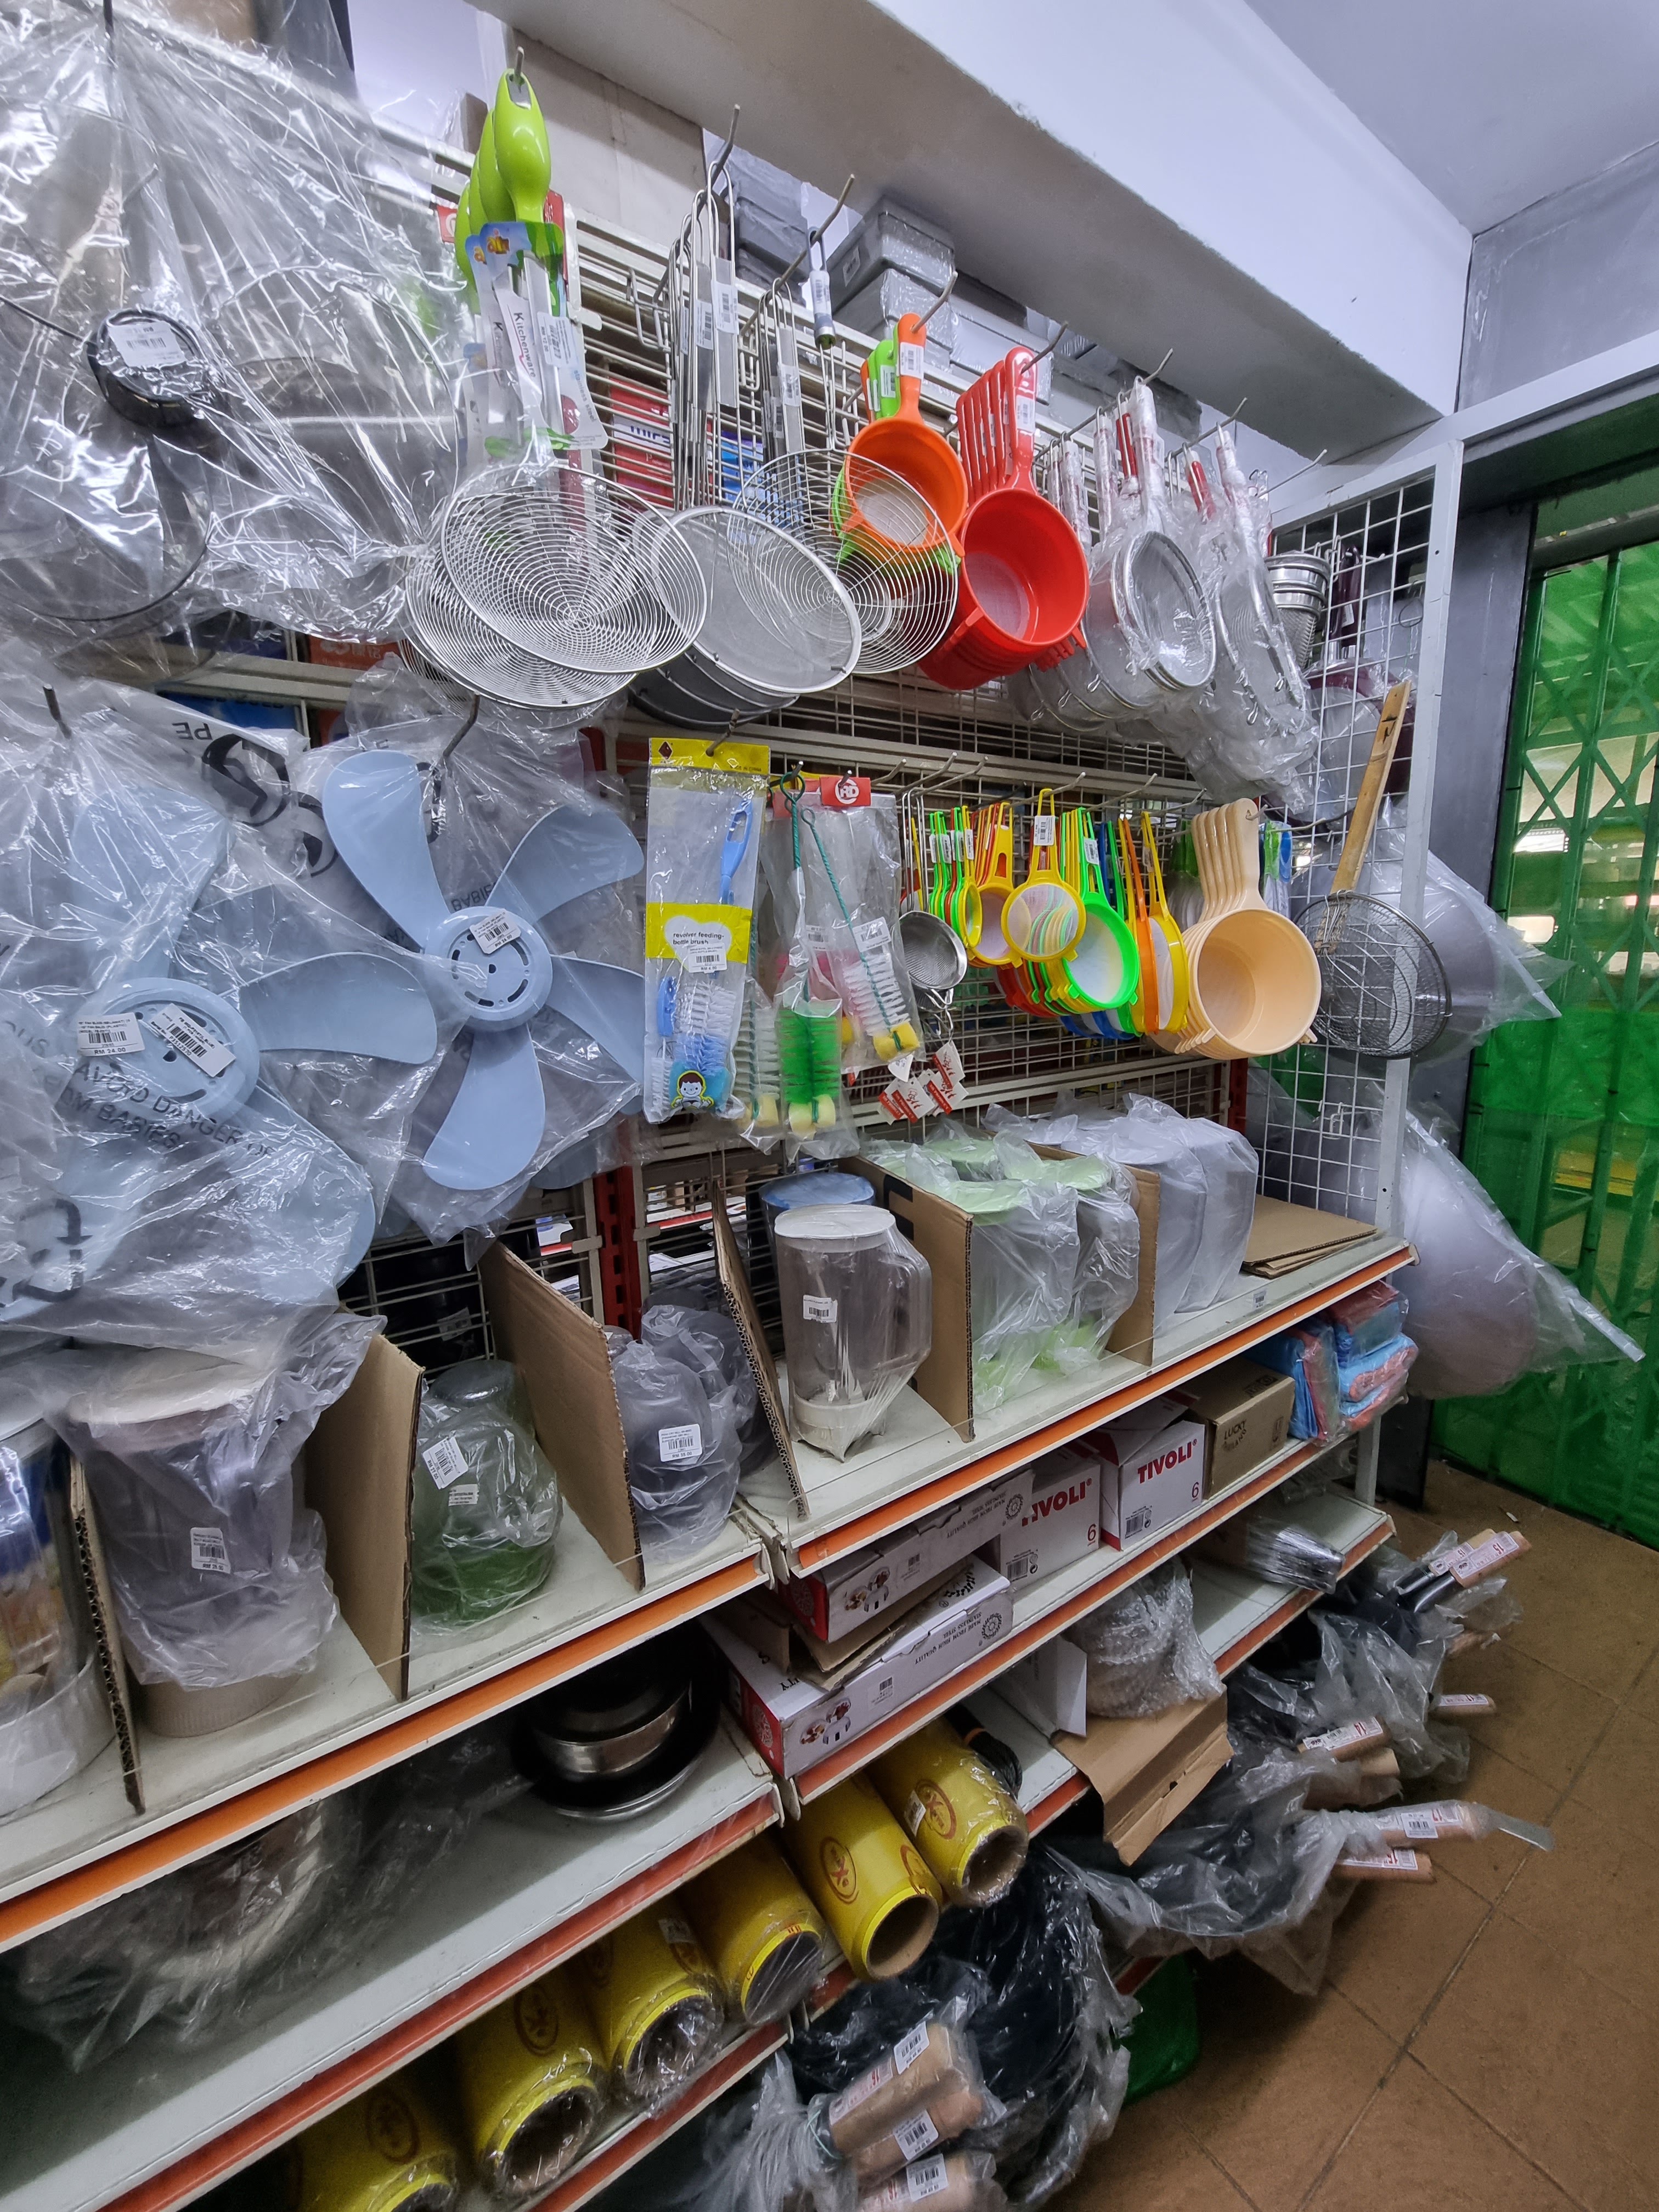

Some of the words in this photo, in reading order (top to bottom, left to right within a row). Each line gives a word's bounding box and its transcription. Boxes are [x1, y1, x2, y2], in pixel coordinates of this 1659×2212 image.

[514, 312, 536, 378] Kitchenware
[574, 370, 587, 402] stainless
[585, 403, 596, 422] steel
[172, 722, 213, 740] PE
[839, 786, 860, 799] RD
[168, 1035, 192, 1056] P3512570
[97, 1103, 181, 1149] BABIES
[153, 1095, 244, 1144] DANGER
[1223, 1419, 1247, 1440] LUCKY
[426, 1459, 433, 1468] RM
[430, 1467, 439, 1480] 27.00
[1137, 1441, 1193, 1483] TIVOLI
[1191, 1481, 1200, 1499] 6
[1022, 1481, 1086, 1527] IVOLI
[946, 1521, 967, 1538] QUALITY
[1087, 1523, 1097, 1542] 6
[955, 1611, 983, 1628] STAINLESS
[966, 1619, 982, 1631] MADE
[941, 1627, 957, 1638] STEEL
[950, 1628, 968, 1640] FROM
[936, 1637, 952, 1649] HIGH
[915, 1646, 938, 1664] QUALITY
